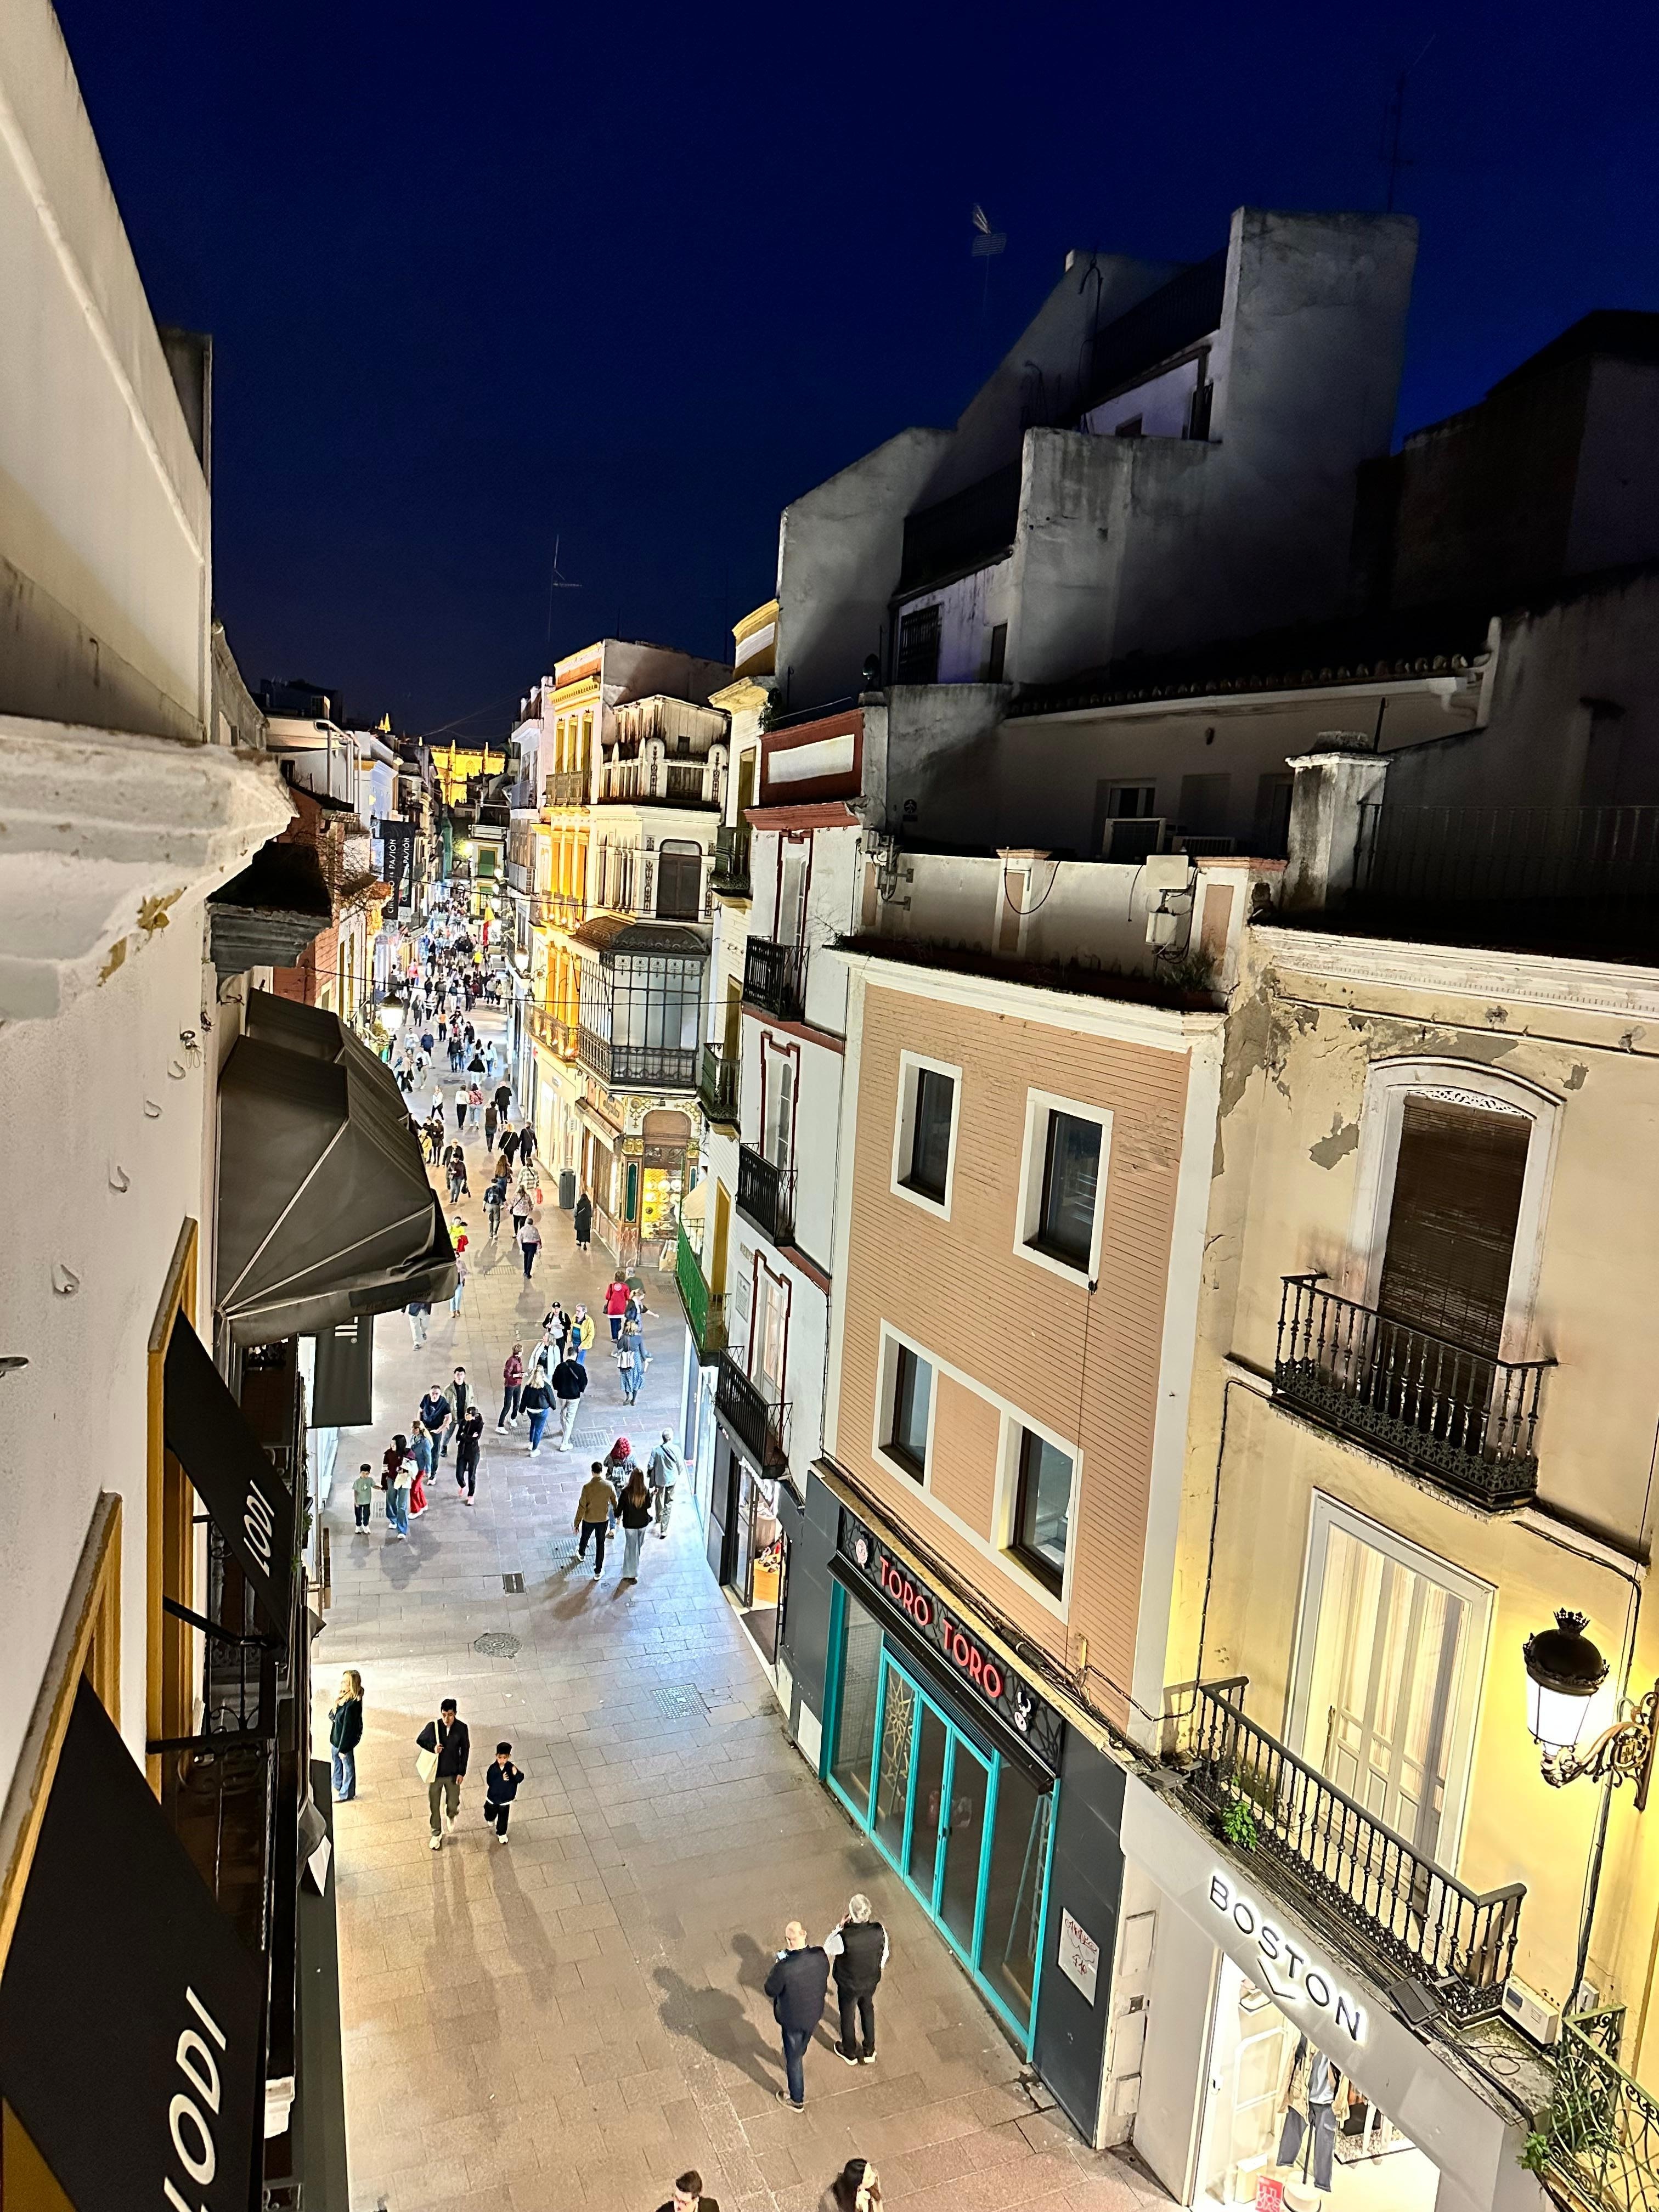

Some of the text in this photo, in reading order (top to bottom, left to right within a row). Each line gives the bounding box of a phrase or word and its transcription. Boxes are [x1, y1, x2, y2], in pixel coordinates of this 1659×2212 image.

[244, 1480, 275, 1578] LODI
[879, 1555, 1003, 1698] TORO TORO
[1210, 1875, 1362, 2041] BOSTON
